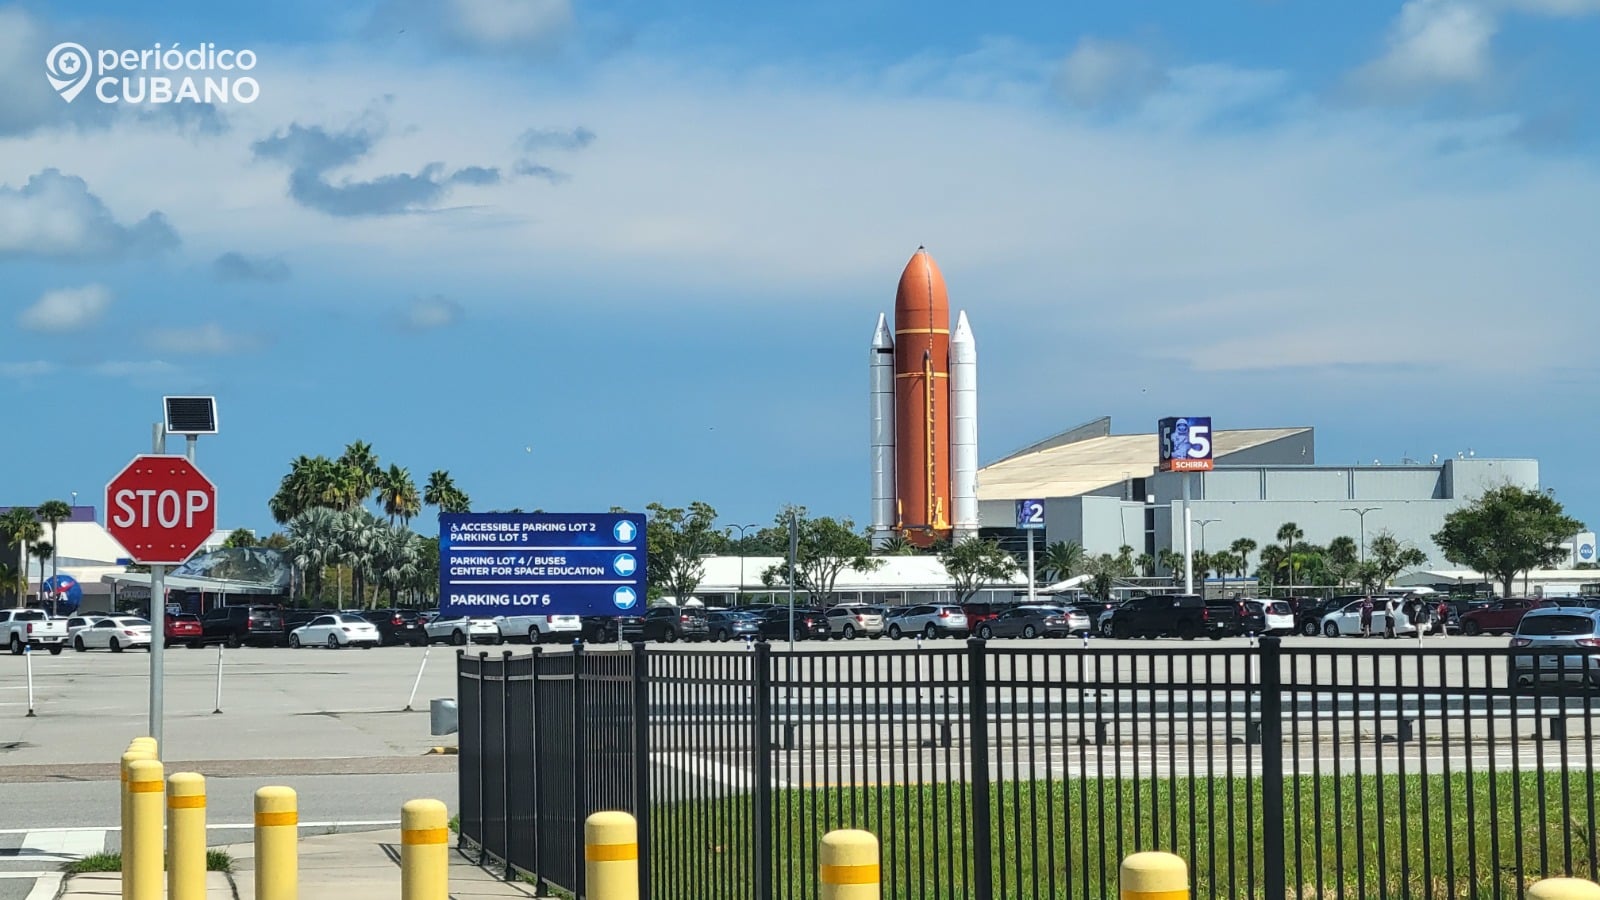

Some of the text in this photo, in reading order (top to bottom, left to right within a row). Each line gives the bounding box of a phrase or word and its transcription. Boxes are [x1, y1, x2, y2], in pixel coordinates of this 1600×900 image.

[1163, 427, 1171, 459] 5
[1187, 425, 1210, 458] 5
[113, 489, 209, 528] STOP
[1029, 503, 1043, 522] 2
[461, 523, 596, 531] ACCESSIBLE PARKING LOT 2
[450, 534, 528, 542] PARKING LOT 5
[450, 557, 566, 566] PARKING LOT 4 / BUSES
[450, 567, 604, 575] CENTER FOR SPACE EDUCATION
[450, 595, 550, 605] PARKING LOT 6
